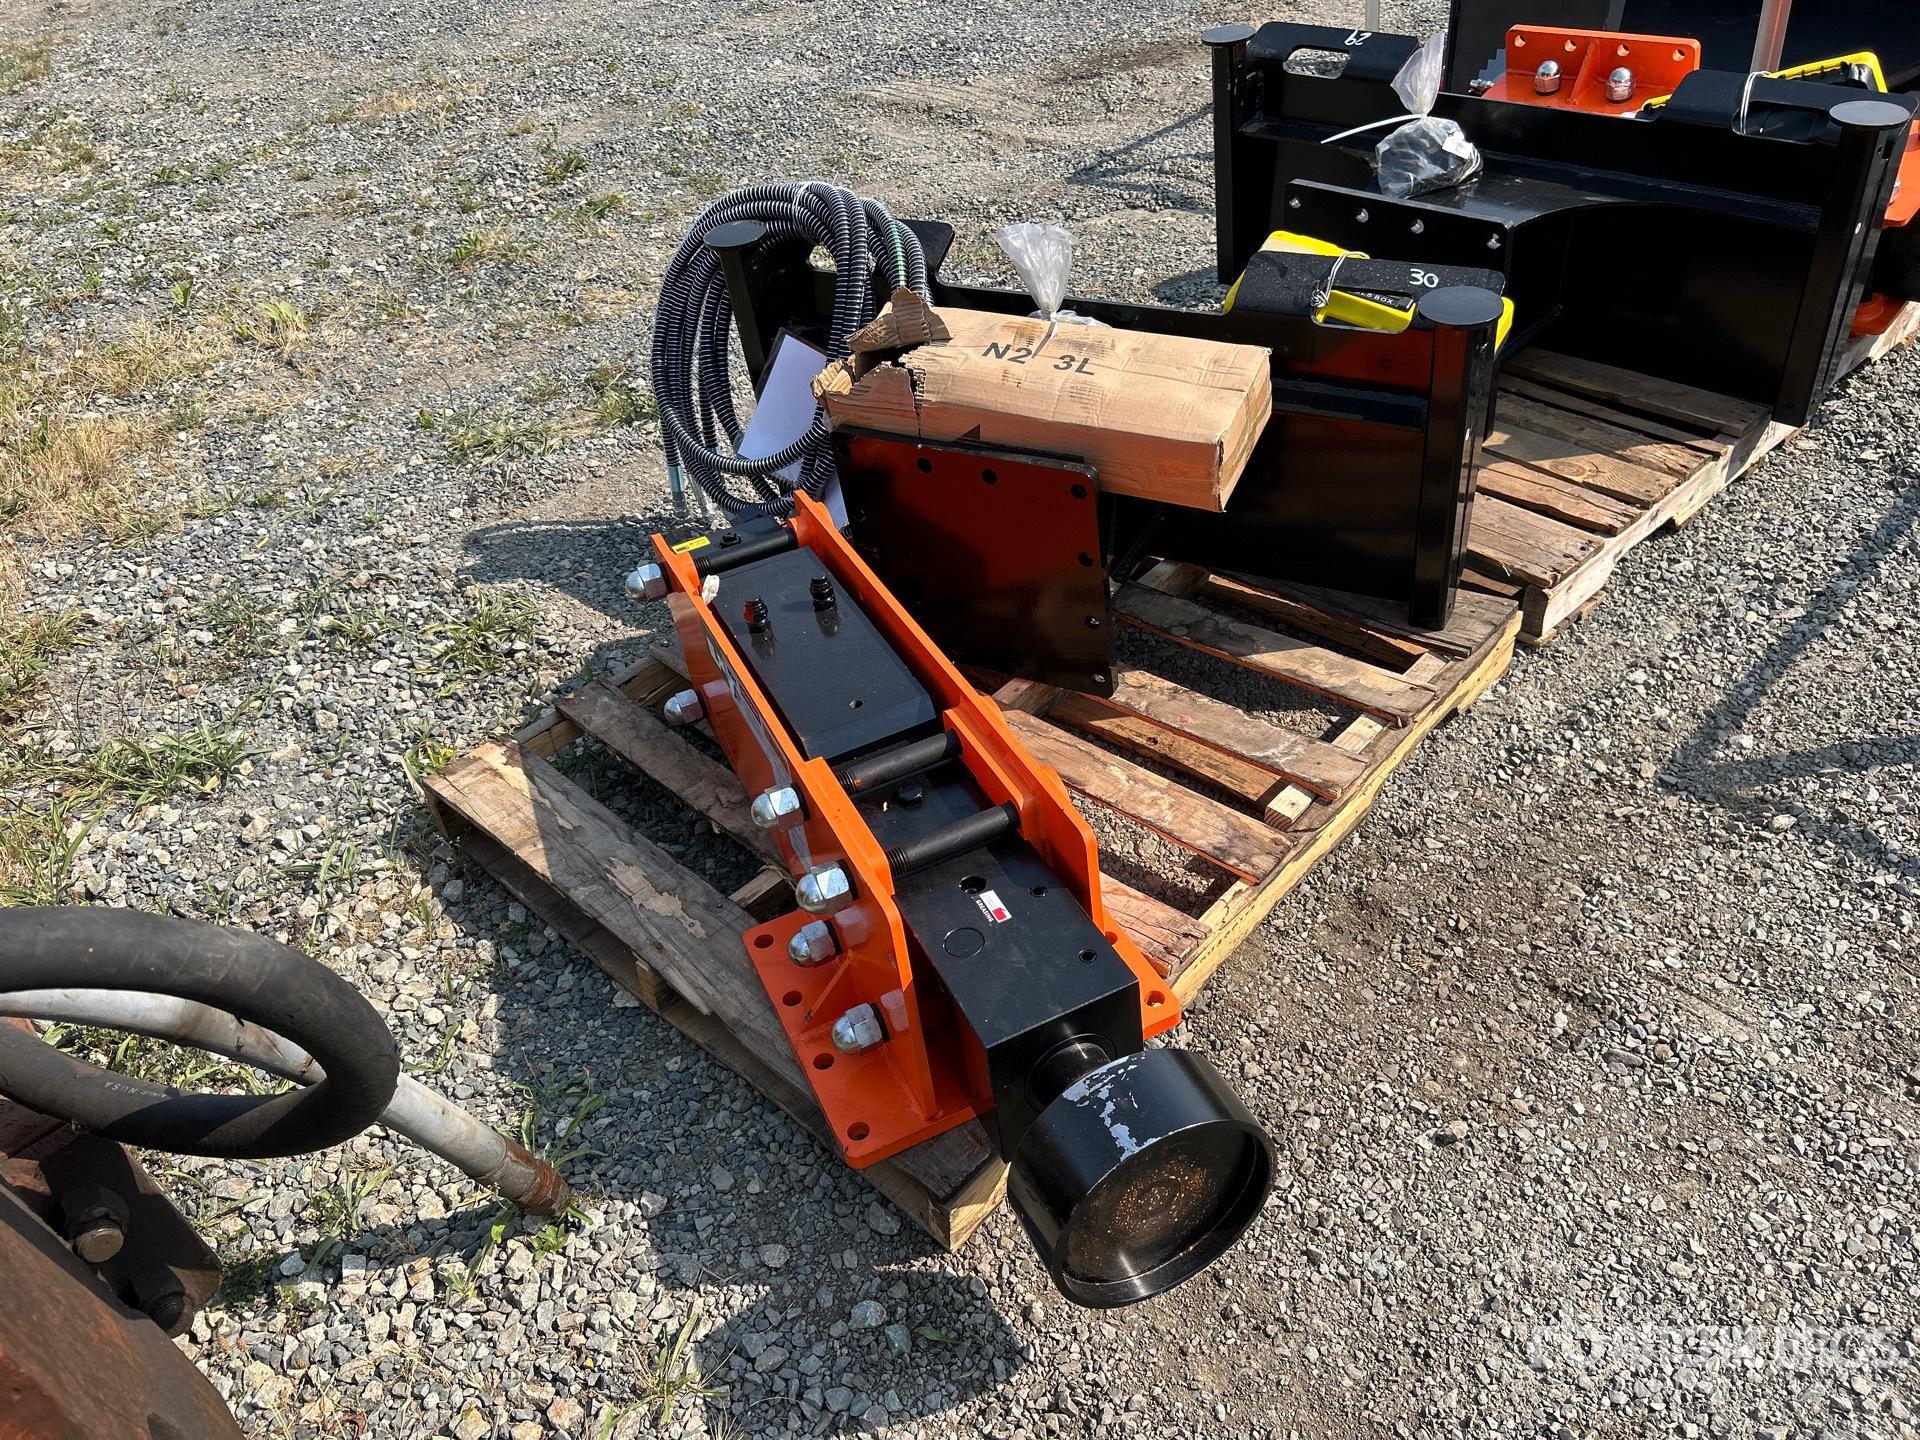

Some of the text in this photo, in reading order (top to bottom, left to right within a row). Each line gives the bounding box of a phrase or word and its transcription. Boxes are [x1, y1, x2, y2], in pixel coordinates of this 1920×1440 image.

[1409, 268, 1439, 288] 30
[1374, 294, 1394, 304] BOX
[981, 342, 1095, 376] N2 3L
[975, 899, 995, 923] GREASING
